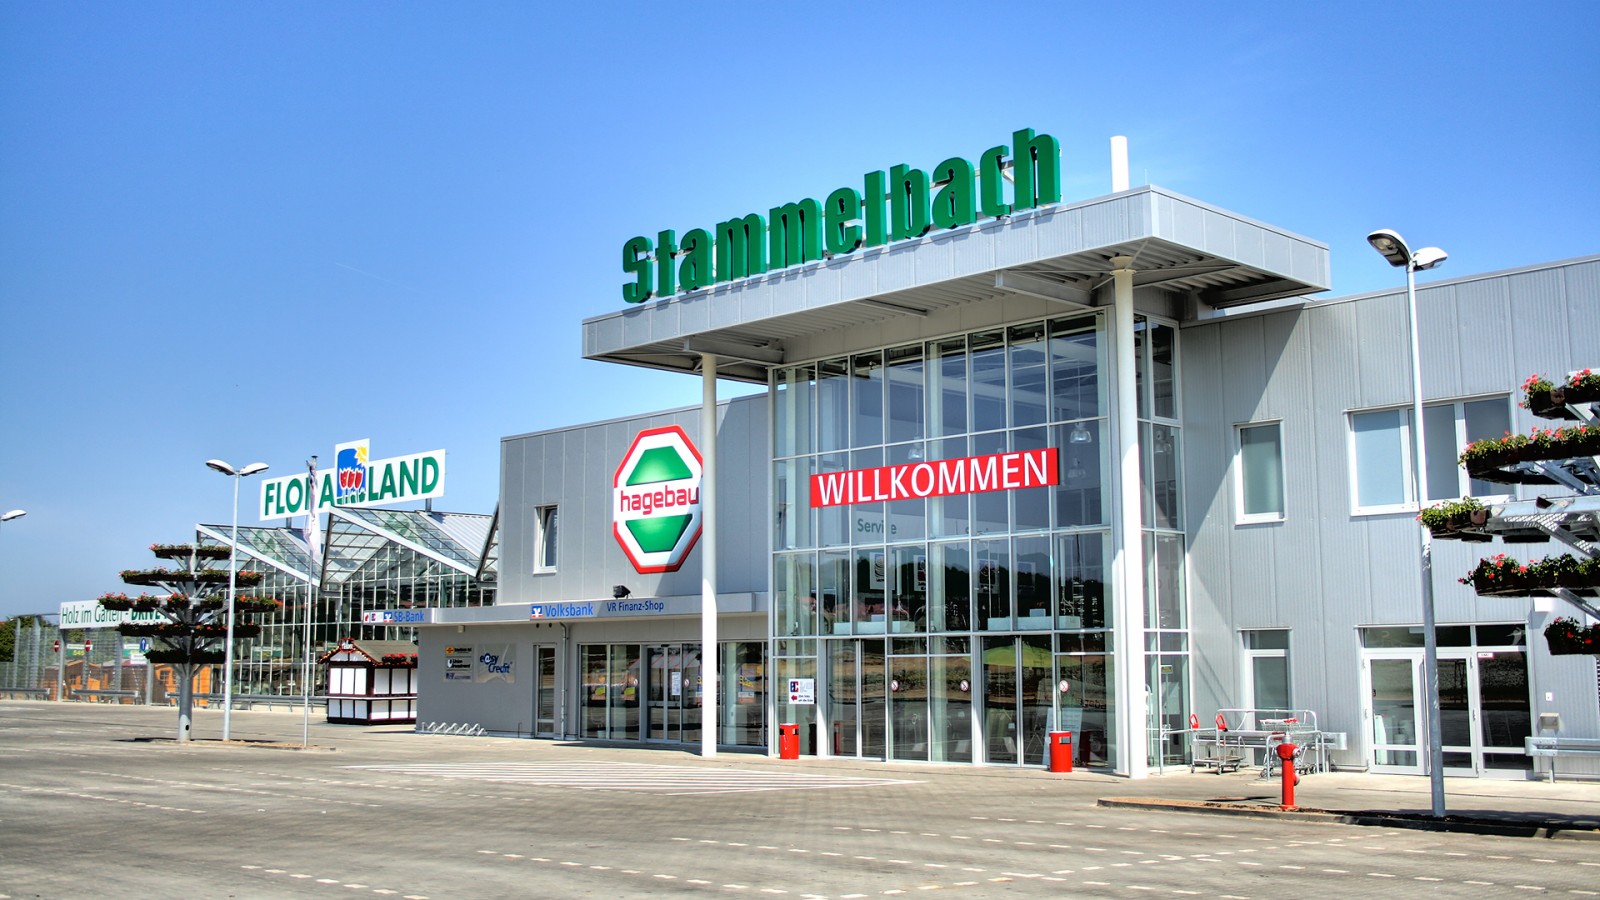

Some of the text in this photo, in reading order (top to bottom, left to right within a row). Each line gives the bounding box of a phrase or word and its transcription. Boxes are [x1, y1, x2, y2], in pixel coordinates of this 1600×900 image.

[622, 127, 1062, 304] Stammelbach
[818, 450, 1048, 506] WILLKOMMEN
[620, 485, 700, 515] hagebau
[857, 518, 897, 534] Servie
[62, 604, 79, 624] Holz
[81, 605, 92, 623] im
[545, 602, 593, 617] Volksbank
[607, 600, 664, 613] VR Finanz-Shop
[394, 610, 425, 623] SB-Bank
